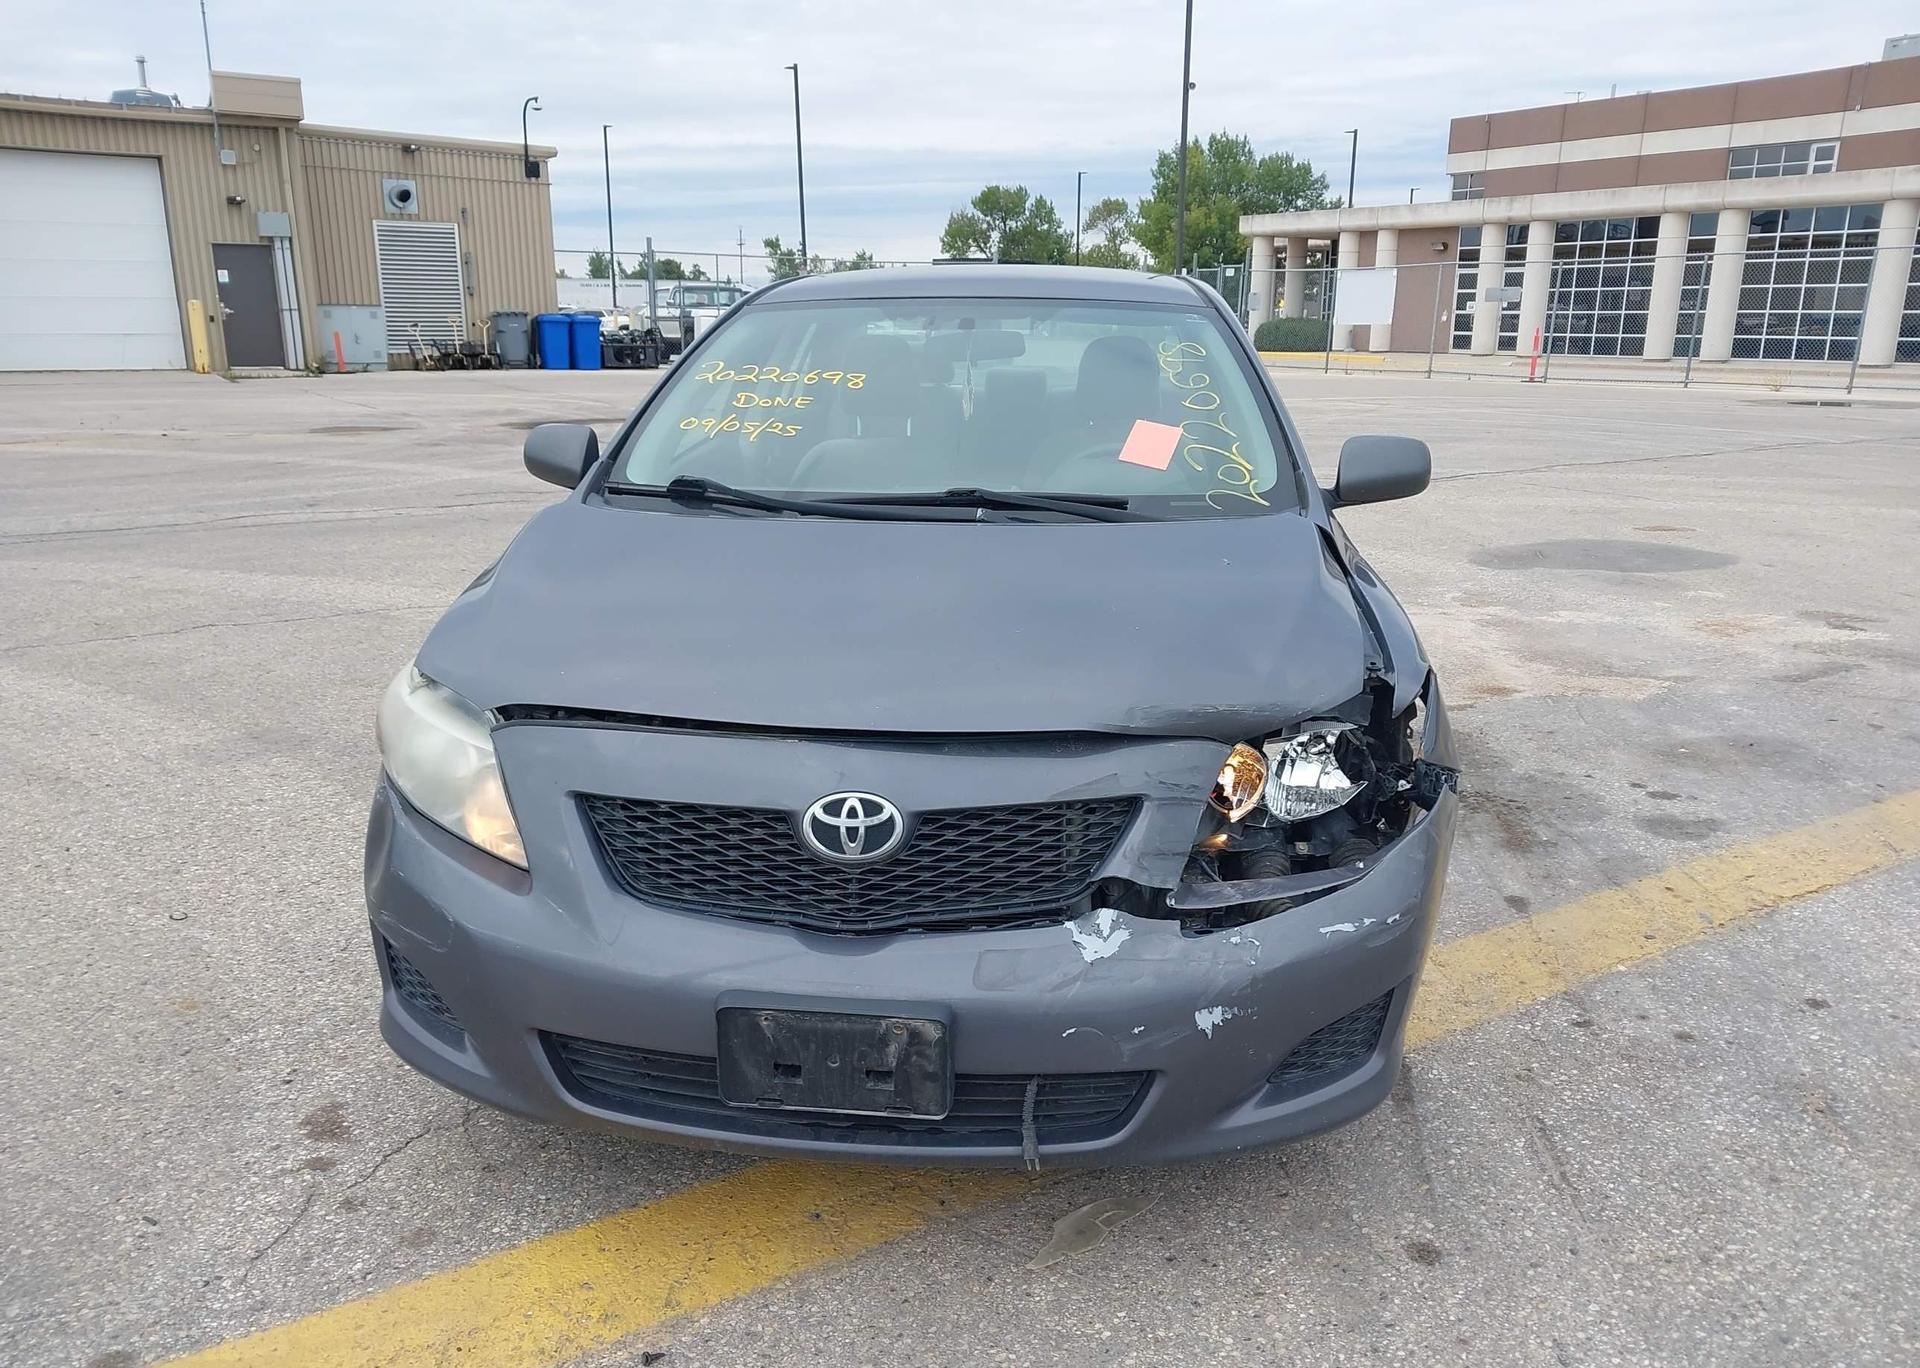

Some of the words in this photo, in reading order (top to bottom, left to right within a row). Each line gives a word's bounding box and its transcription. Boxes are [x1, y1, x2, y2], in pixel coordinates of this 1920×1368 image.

[695, 360, 867, 389] 20220698
[679, 413, 804, 442] 09/05/25
[1158, 342, 1271, 511] 20220698
